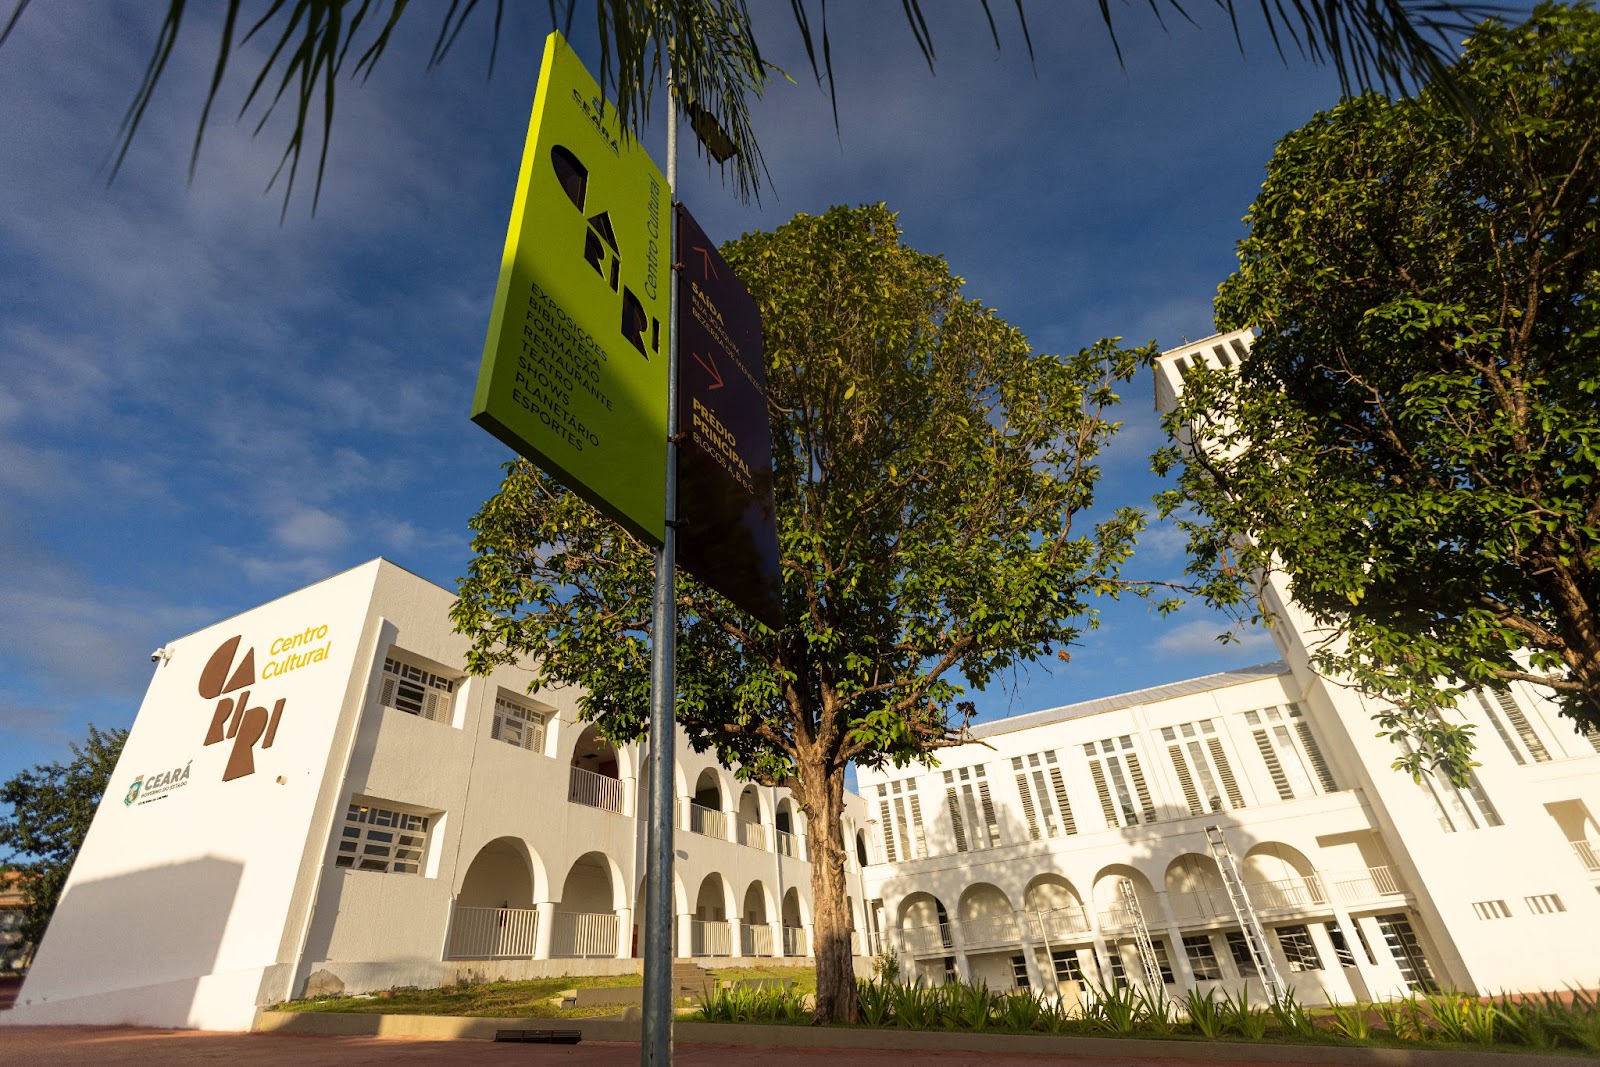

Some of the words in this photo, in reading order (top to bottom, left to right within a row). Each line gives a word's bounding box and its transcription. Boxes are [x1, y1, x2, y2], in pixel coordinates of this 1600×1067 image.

[573, 88, 620, 155] CEARÁ
[647, 172, 660, 239] Cultural
[644, 240, 659, 301] Centro
[528, 296, 600, 371] BIBLIOTECA
[531, 282, 607, 362] EXPOSIÇÕES
[692, 281, 725, 326] SAÍDA
[522, 339, 573, 391] TEATRO
[524, 325, 613, 412] RESTAURANTE
[526, 311, 600, 383] FORMAÇÃO
[515, 371, 599, 447] PLANETÁRIO
[518, 356, 569, 406] SHOWS
[512, 388, 583, 451] ESPORTES
[693, 397, 736, 447] PRÉDIO
[693, 413, 752, 479] PRINCIPAL
[693, 431, 727, 468] BLOCOS
[262, 640, 331, 680] Cultural
[270, 624, 328, 656] Centro
[144, 759, 193, 791] CEARÁ
